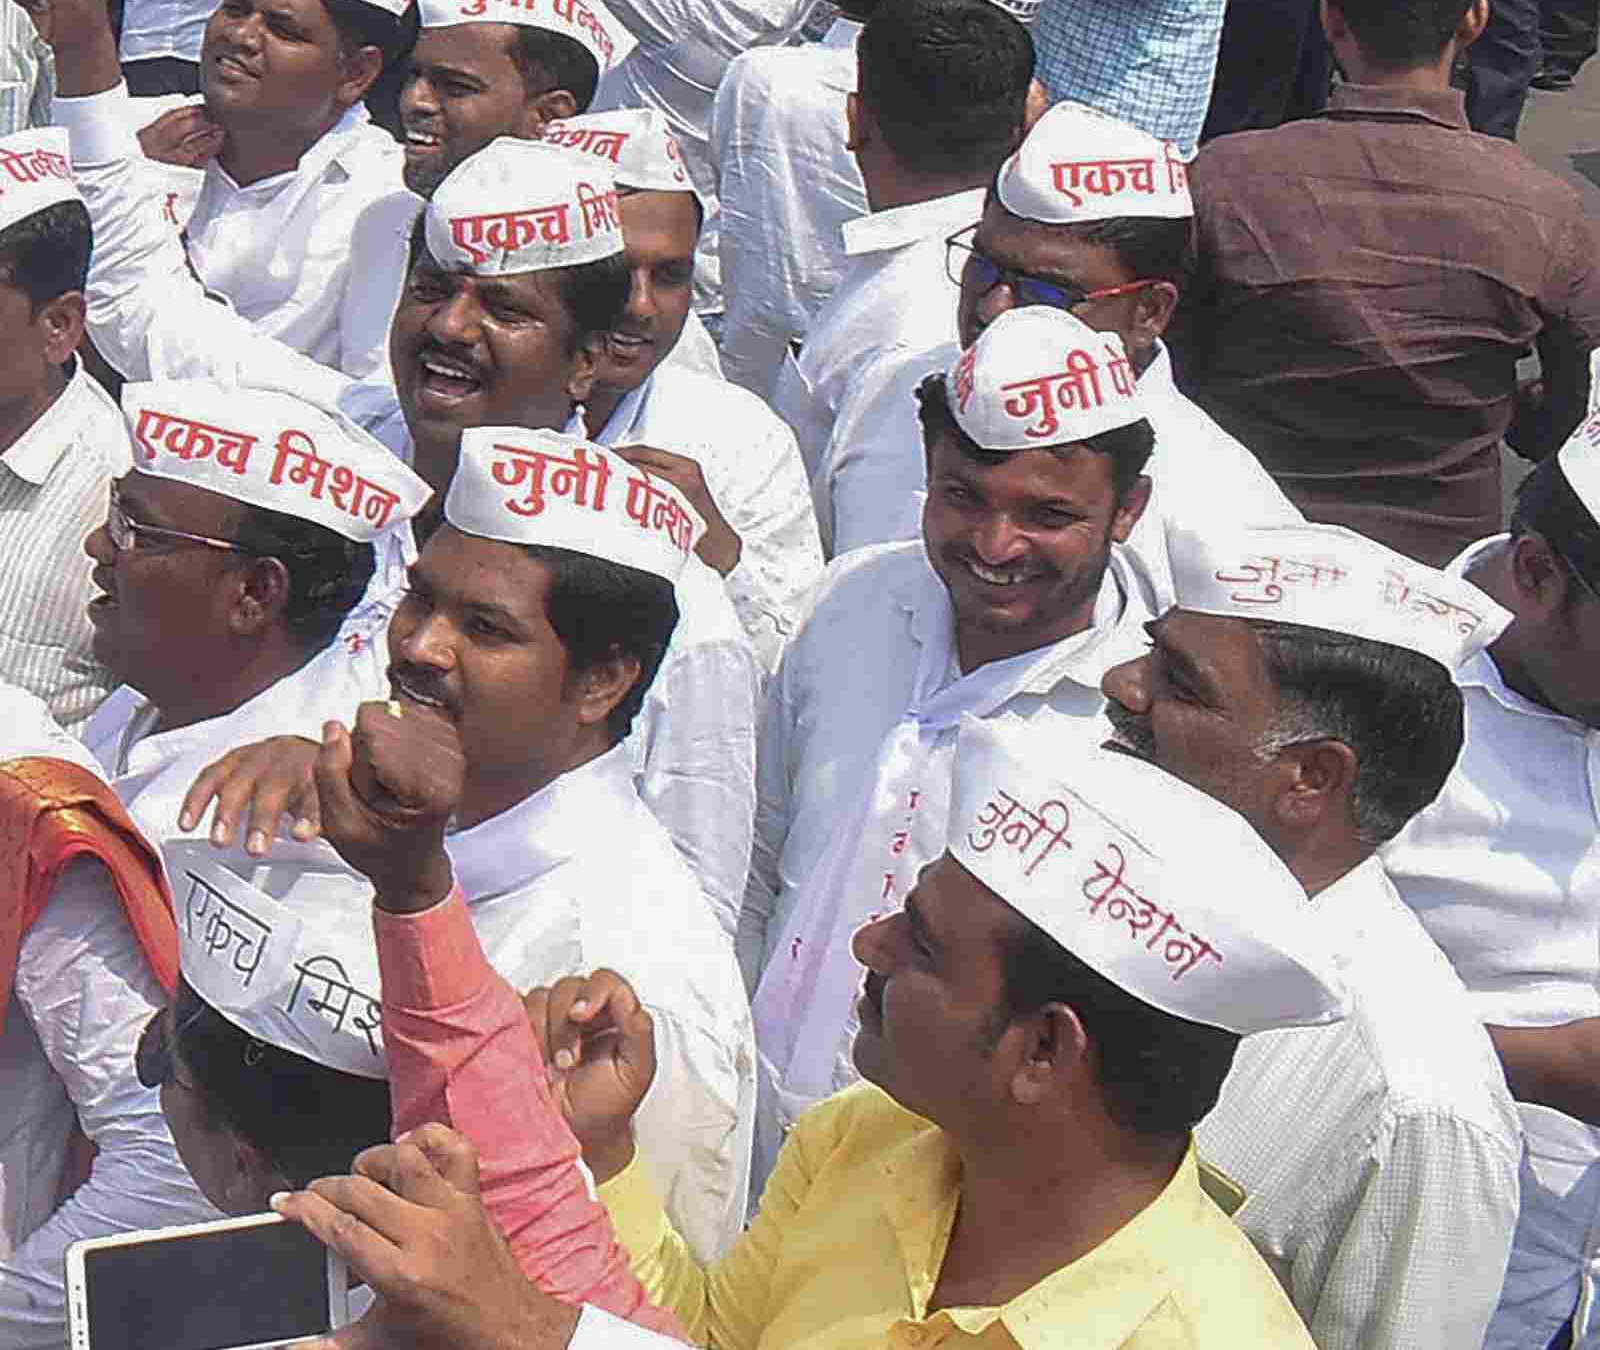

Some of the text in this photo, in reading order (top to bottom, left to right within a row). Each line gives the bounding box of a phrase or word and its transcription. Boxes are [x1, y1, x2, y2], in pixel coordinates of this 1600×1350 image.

[1049, 159, 1154, 208] एकच
[452, 202, 571, 265] एकच
[1002, 348, 1103, 438] जुनी
[134, 406, 403, 534] एकच मिशन
[490, 442, 613, 518] जुनी
[965, 787, 1074, 878] जुनी
[1082, 842, 1224, 984] पेन्शन
[287, 955, 383, 1056] मिश
